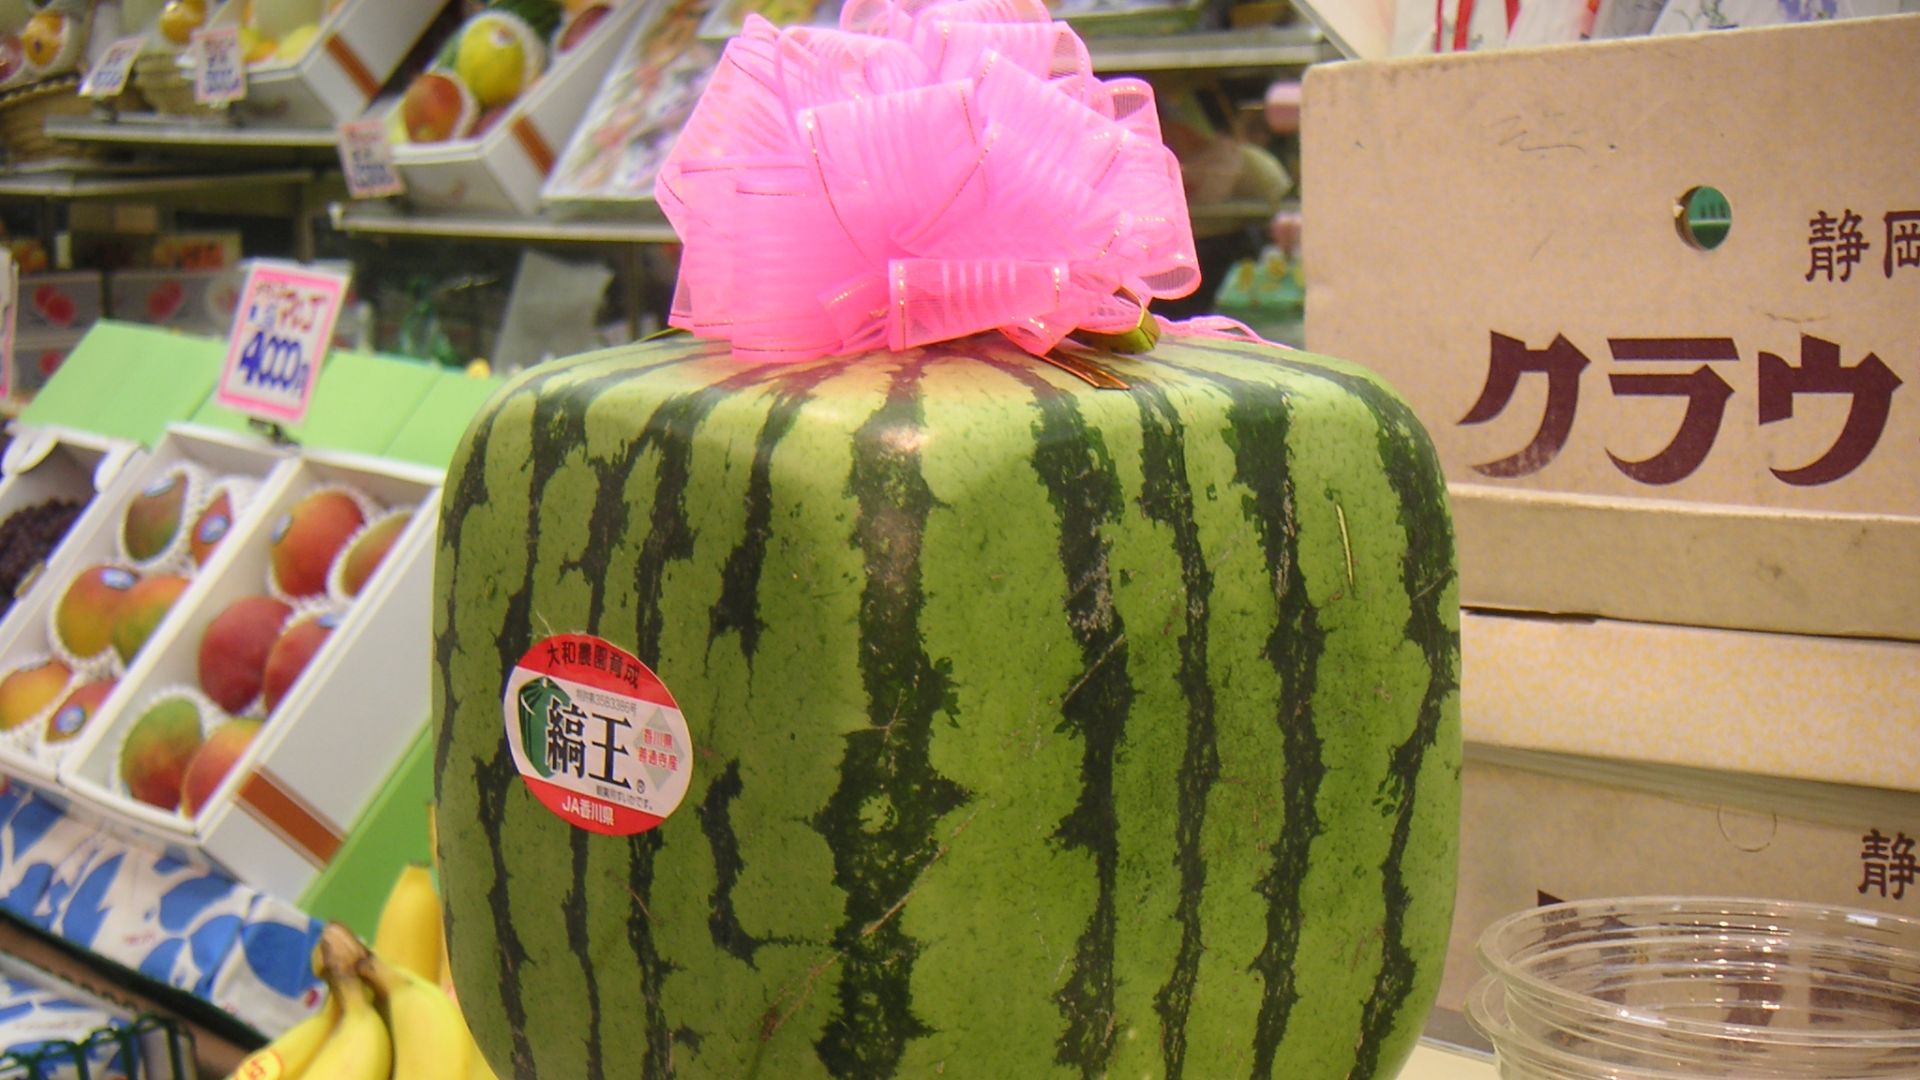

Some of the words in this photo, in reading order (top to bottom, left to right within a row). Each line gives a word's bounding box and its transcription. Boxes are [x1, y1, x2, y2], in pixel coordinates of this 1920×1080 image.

[1456, 330, 1904, 486] クラウ
[547, 641, 640, 689] 大和農園育成
[547, 697, 632, 790] 縞王
[561, 795, 615, 826] JA香川県
[1857, 828, 1920, 899] 静
